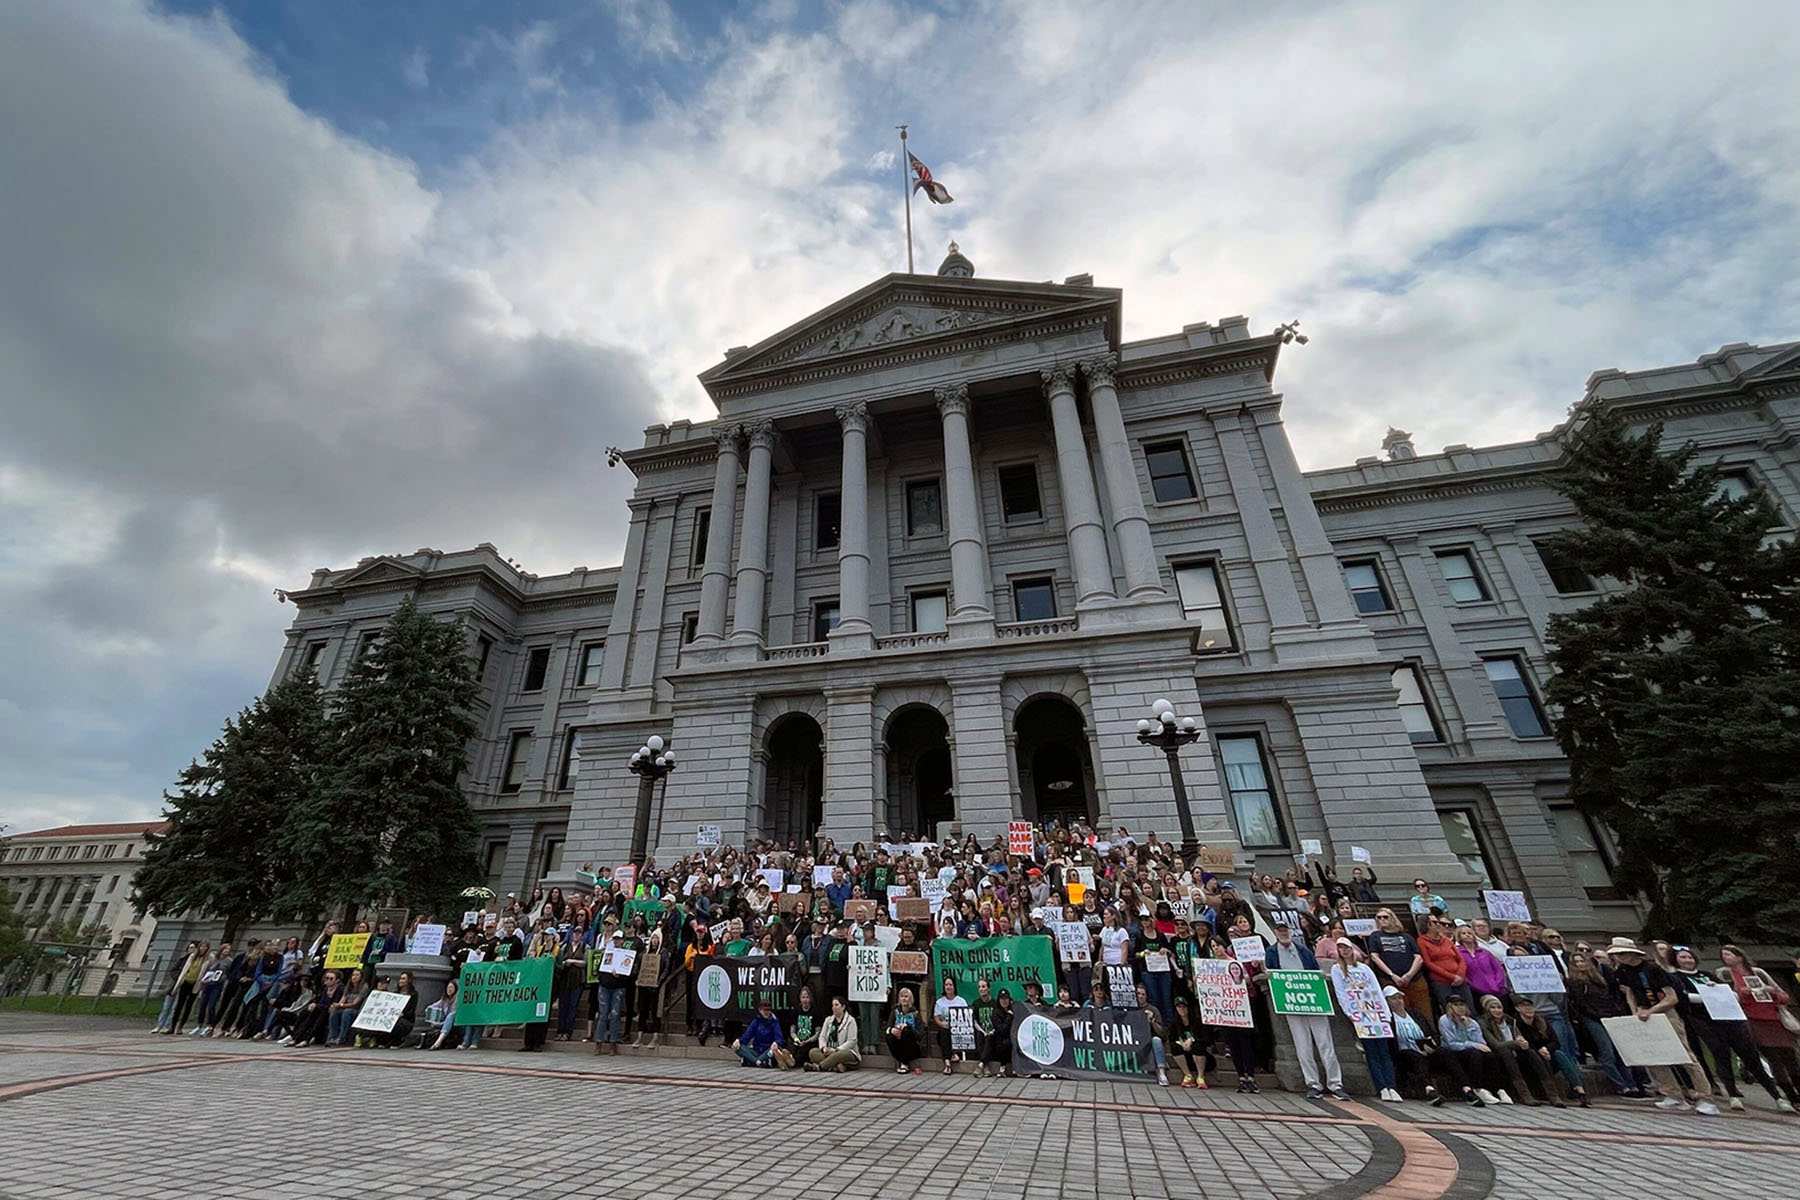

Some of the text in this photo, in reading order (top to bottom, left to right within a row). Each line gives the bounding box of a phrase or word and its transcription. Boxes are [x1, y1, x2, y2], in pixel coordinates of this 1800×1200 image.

[1009, 822, 1032, 832] BANG
[1010, 833, 1032, 843] BANG
[1010, 844, 1033, 853] BANG
[856, 950, 879, 965] HERE
[940, 948, 1010, 965] BAN GUNS &
[1505, 957, 1554, 970] Colorado
[465, 972, 485, 987] BAN
[488, 971, 515, 986] GUNS
[738, 967, 790, 985] WE CAN.
[969, 967, 1003, 983] THEM
[1007, 966, 1041, 981] BACK
[1107, 966, 1133, 984] BAN
[1272, 972, 1320, 981] Regulate
[856, 975, 879, 992] KIDS
[1110, 984, 1136, 992] GUNS
[463, 986, 538, 1004] BUY THEM BACK
[1222, 986, 1246, 998] KEMP
[1285, 992, 1316, 1004] NOT
[738, 991, 755, 1010] WE
[1205, 998, 1218, 1007] GA
[1222, 999, 1243, 1009] GOP
[1351, 1001, 1383, 1010] GUNS
[1284, 1003, 1324, 1012] Women
[950, 1009, 973, 1026] BAN
[1352, 1012, 1392, 1024] SAVE
[951, 1026, 975, 1035] GUNS
[1072, 1020, 1140, 1045] WE CAN.
[1357, 1024, 1391, 1037] KIDS
[1032, 1040, 1050, 1058] KIDS
[1073, 1047, 1148, 1074] WE WILL.
